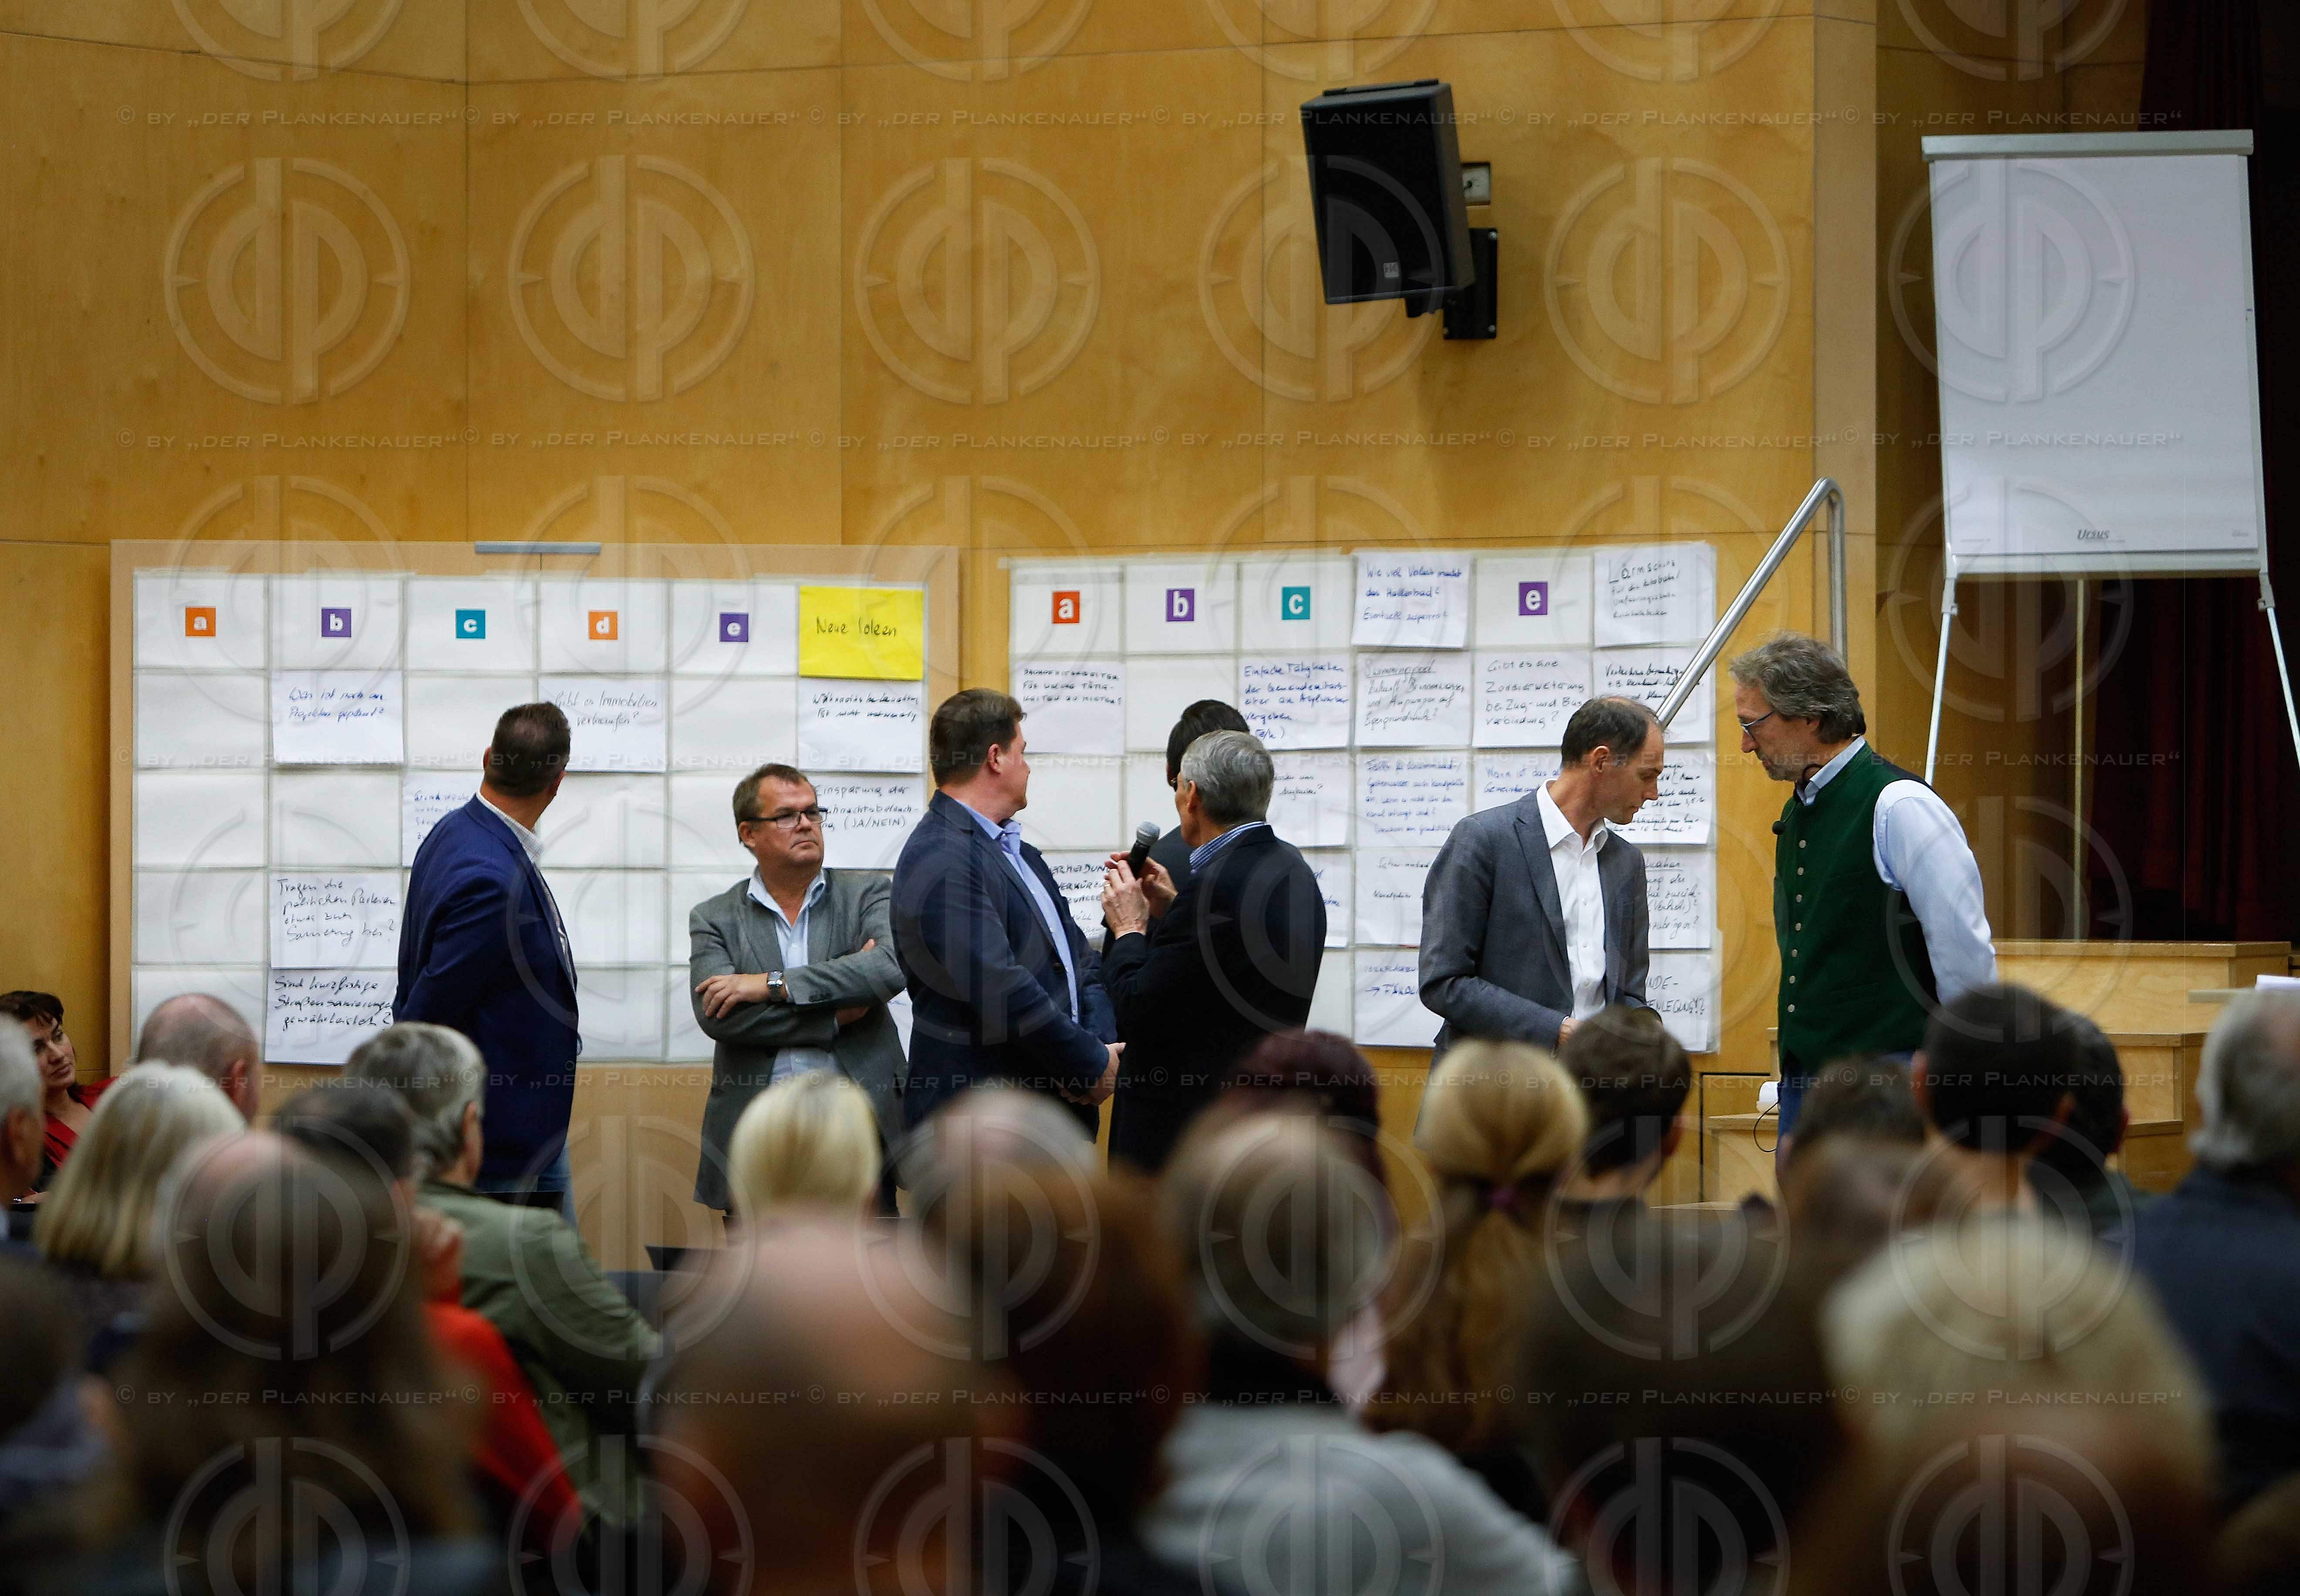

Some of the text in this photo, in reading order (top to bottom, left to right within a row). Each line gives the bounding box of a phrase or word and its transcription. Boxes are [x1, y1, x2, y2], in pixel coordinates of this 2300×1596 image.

[1059, 597, 1074, 619] a
[1172, 590, 1189, 618] b
[1288, 593, 1304, 614] c
[1525, 589, 1541, 612] e
[193, 616, 207, 631] a
[329, 613, 345, 632] b
[463, 619, 478, 633] c
[596, 616, 610, 634] d
[727, 622, 742, 637] e
[816, 616, 849, 635] Neue
[599, 690, 659, 708] Immobilien
[888, 784, 910, 795] der
[274, 975, 303, 990] Sind
